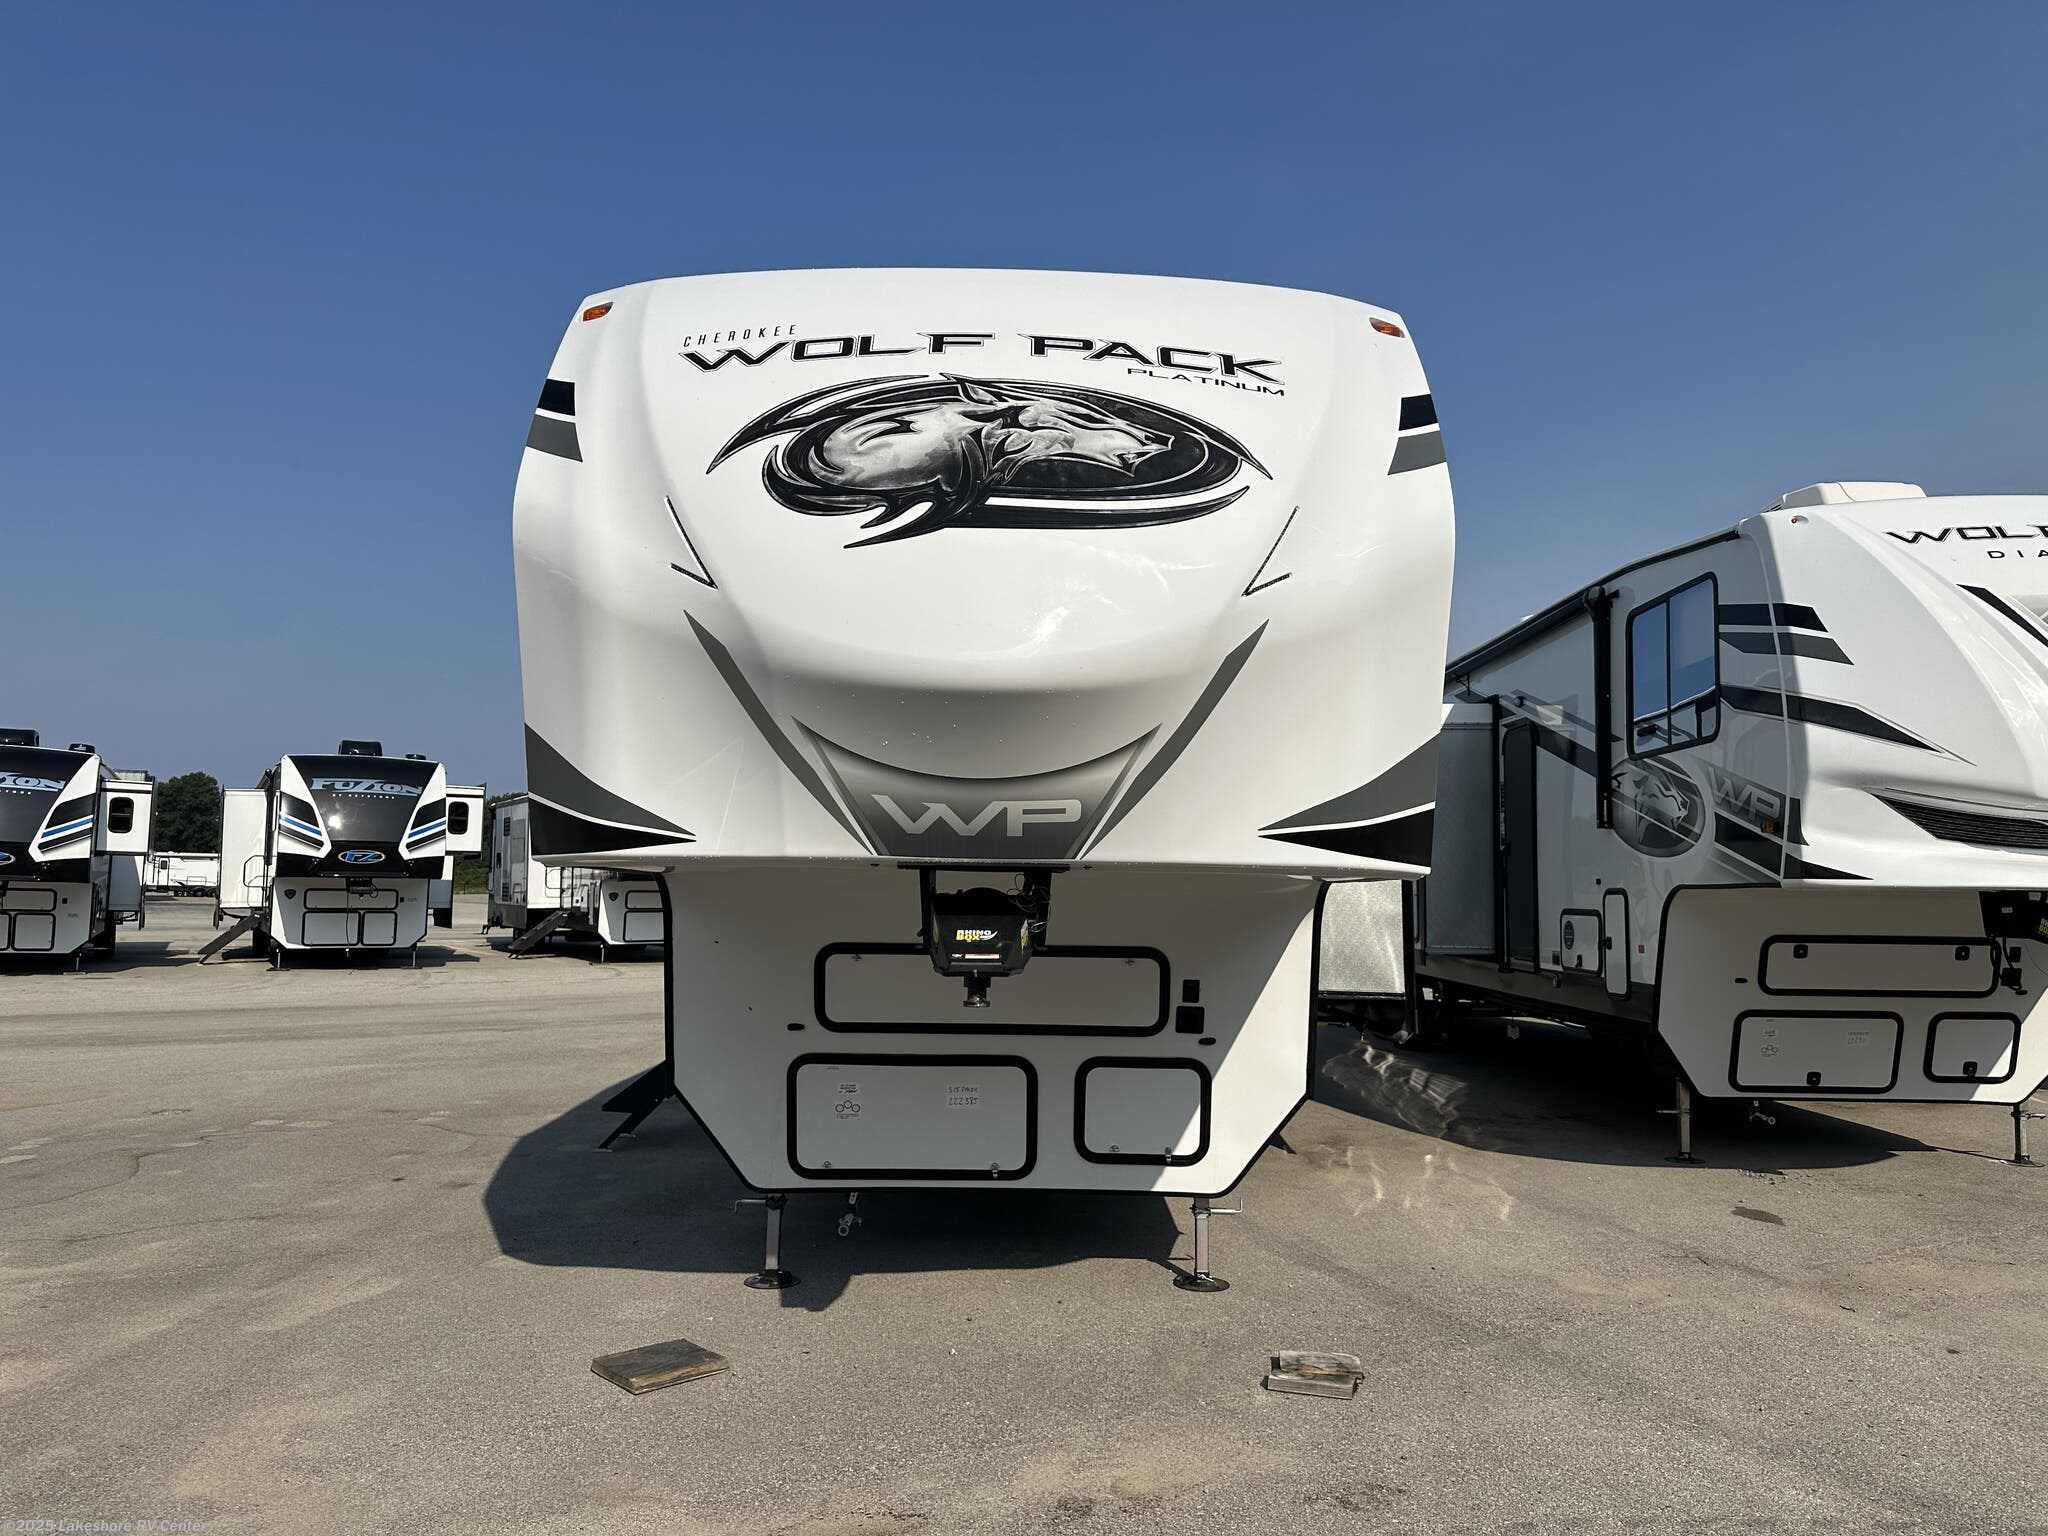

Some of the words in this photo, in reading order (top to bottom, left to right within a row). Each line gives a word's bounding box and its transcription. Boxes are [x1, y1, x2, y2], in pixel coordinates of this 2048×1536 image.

[683, 325, 796, 347] CHEROKEE
[679, 332, 995, 373] WOLF
[1017, 333, 1285, 385] PACK
[1127, 367, 1285, 397] PLATINUM
[310, 777, 423, 797] FUZION
[1708, 766, 1781, 820] WP
[871, 794, 1082, 837] WP
